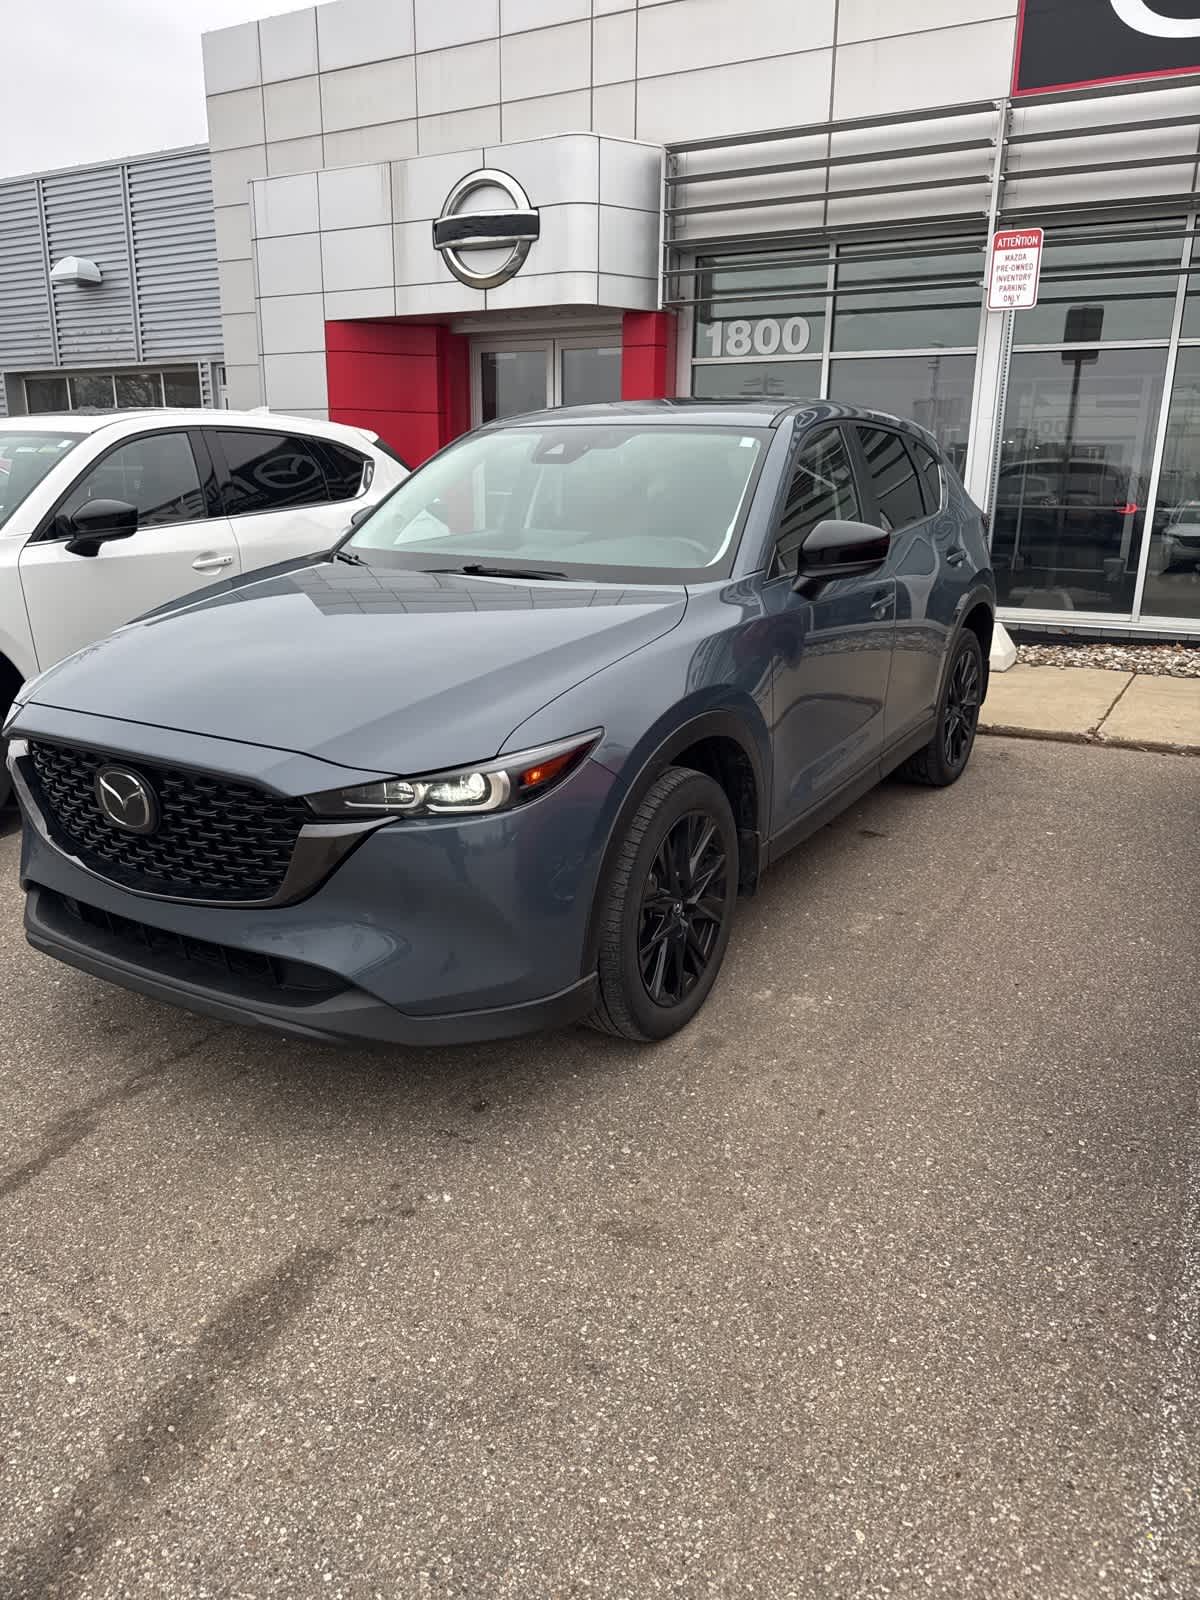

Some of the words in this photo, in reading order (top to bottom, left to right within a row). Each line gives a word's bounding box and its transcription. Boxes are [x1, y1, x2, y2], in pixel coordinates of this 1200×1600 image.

[997, 234, 1038, 248] ATTENTION
[1005, 253, 1027, 261] MAZDA
[996, 262, 1033, 272] PRE-OWNED
[996, 273, 1032, 283] INVENTORY
[999, 284, 1027, 292] PARKING
[1003, 294, 1021, 302] ONLY
[706, 316, 810, 356] 1800
